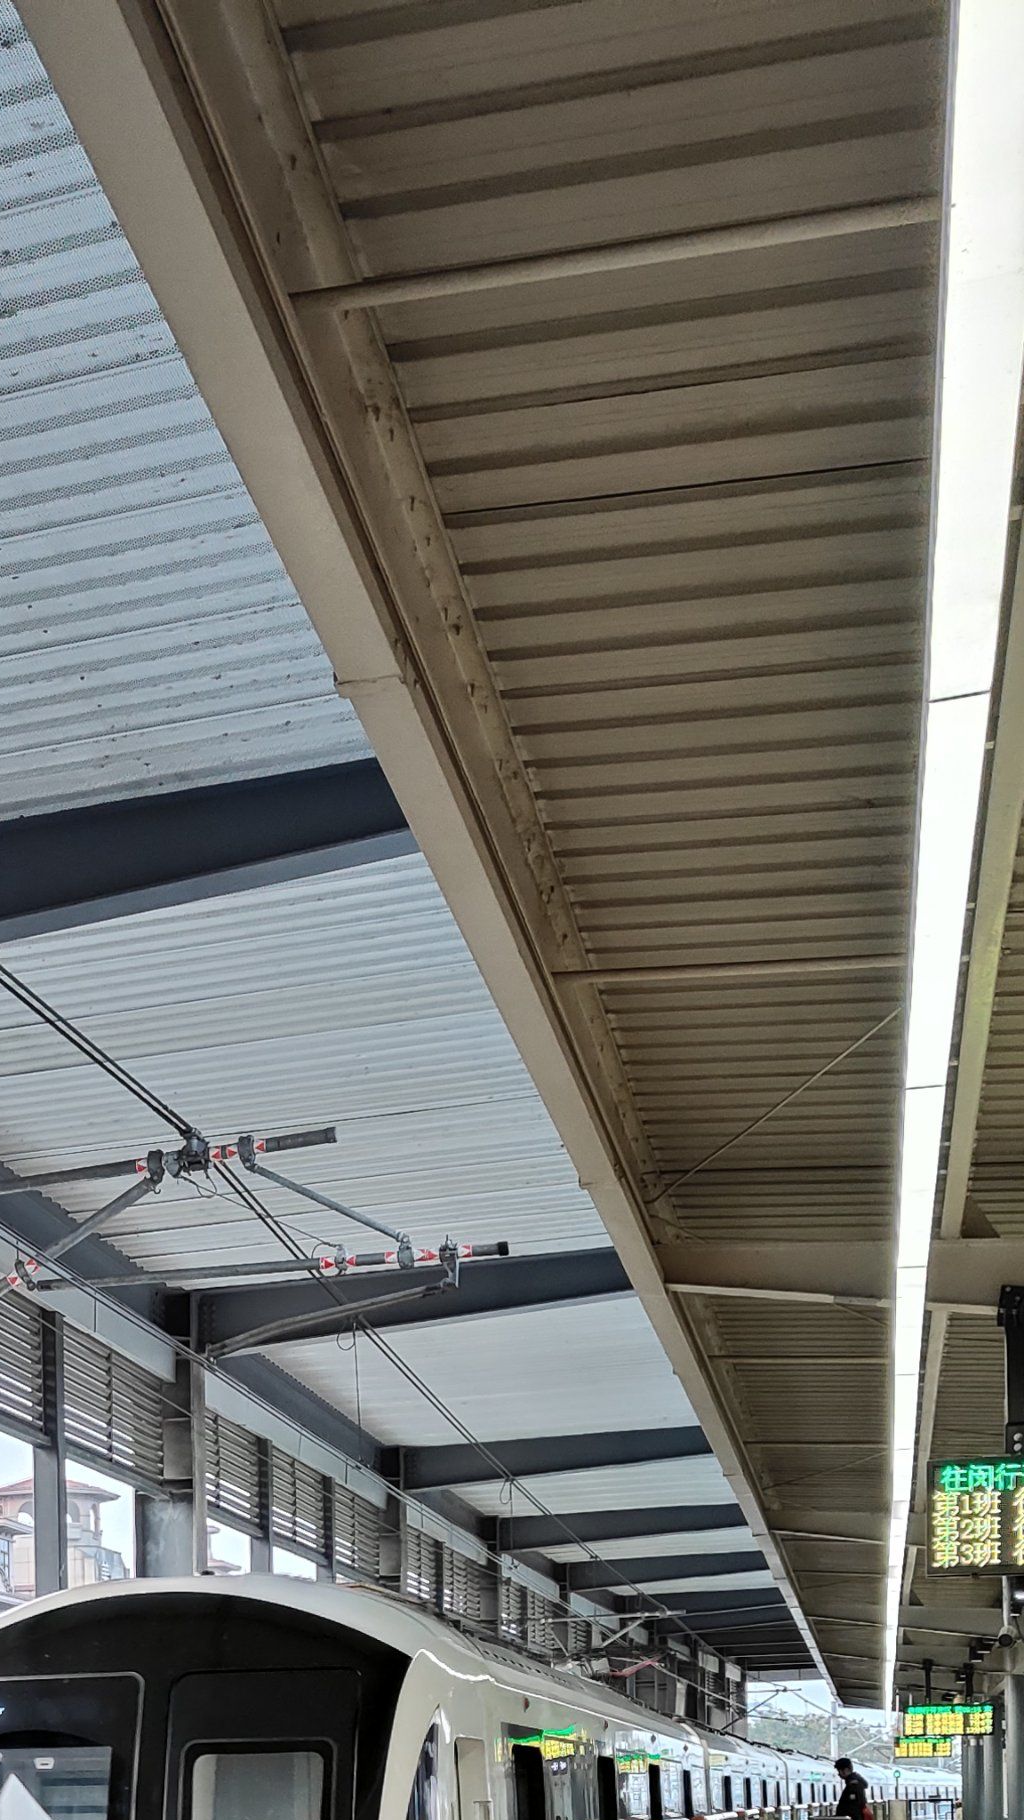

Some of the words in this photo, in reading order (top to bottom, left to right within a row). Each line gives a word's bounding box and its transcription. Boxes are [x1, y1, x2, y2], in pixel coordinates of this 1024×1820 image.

[932, 1490, 1001, 1516] 第1班
[932, 1515, 1001, 1541] 第2班
[932, 1540, 1001, 1568] 第3班
